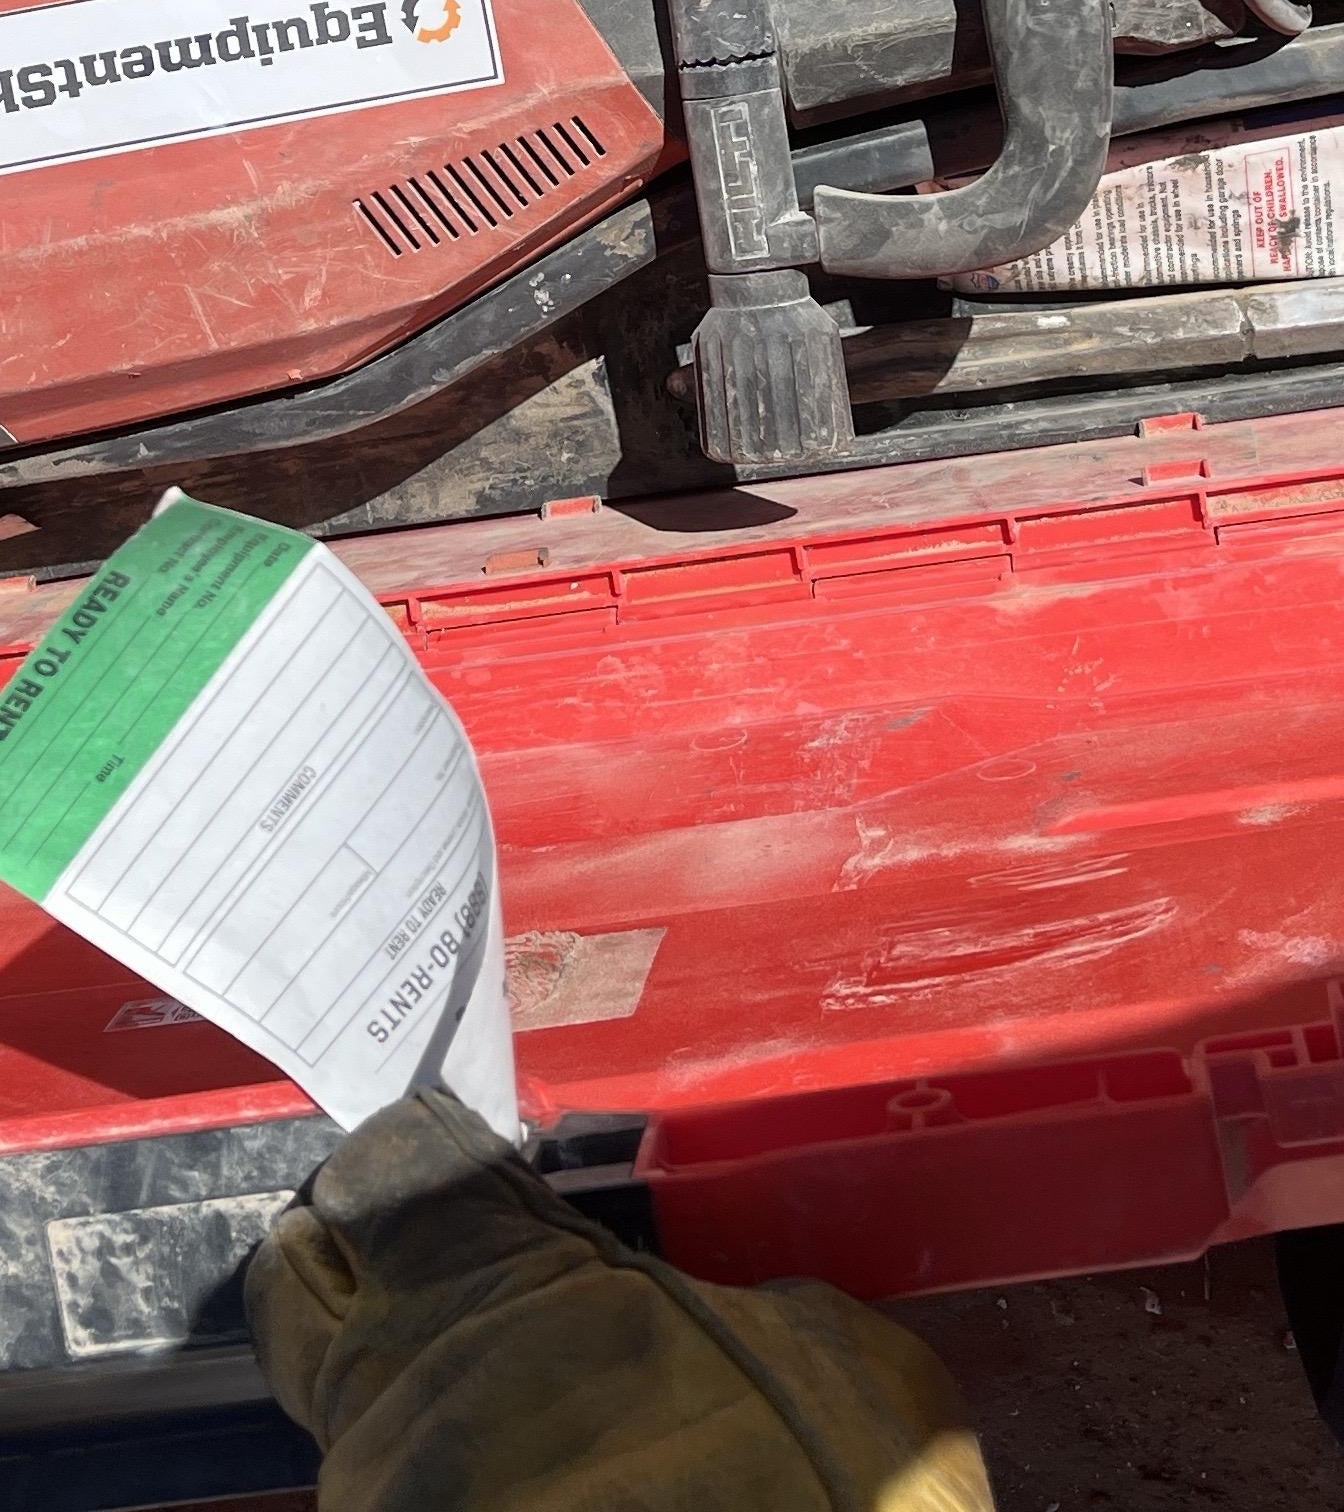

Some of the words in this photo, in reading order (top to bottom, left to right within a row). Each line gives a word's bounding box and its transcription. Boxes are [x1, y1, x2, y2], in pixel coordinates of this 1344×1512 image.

[1215, 159, 1223, 176] door
[1217, 178, 1227, 203] garage
[1252, 191, 1262, 202] OF
[1275, 157, 1287, 217] SWALLOWED.
[1207, 220, 1215, 229] for
[1218, 206, 1228, 238] including
[1231, 210, 1242, 236] springs
[1254, 206, 1263, 224] OUT
[1233, 239, 1241, 251] and
[1255, 227, 1265, 248] KEEP
[1267, 235, 1278, 264] REACH
[183, 525, 244, 582] Employee's
[211, 532, 268, 590] Equipment
[263, 542, 291, 567] Date
[61, 570, 130, 644] READY
[156, 583, 190, 616] Name
[33, 645, 71, 678] TO
[95, 753, 126, 785] Time
[260, 766, 318, 833] COMMENTS
[421, 881, 447, 919] READY
[406, 918, 422, 934] TO
[386, 930, 410, 960] RENT
[367, 931, 460, 1043] 80-RENTS
